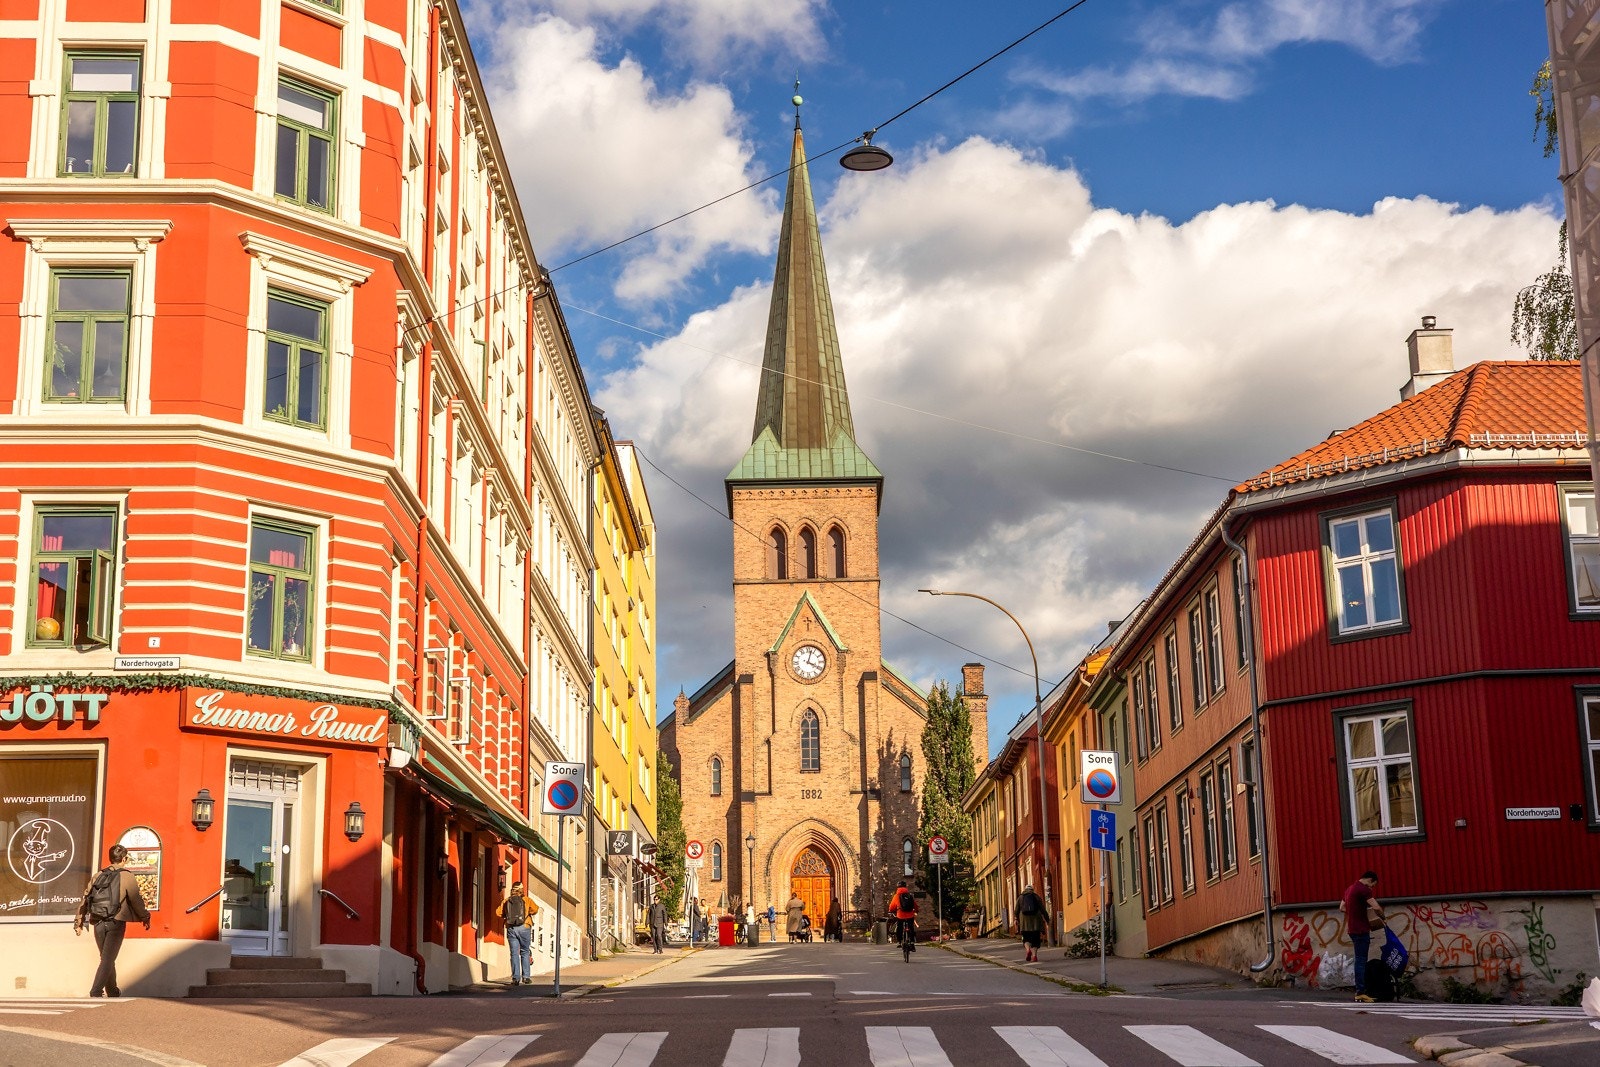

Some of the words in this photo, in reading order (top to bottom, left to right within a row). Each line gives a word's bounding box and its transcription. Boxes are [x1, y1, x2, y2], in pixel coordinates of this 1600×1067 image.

[121, 660, 174, 668] Norderhovgata
[0, 685, 108, 721] JÖTT
[192, 691, 298, 734] Gunnar
[301, 704, 387, 744] Ruud
[1088, 754, 1113, 764] Sone
[552, 764, 578, 775] Sone
[3, 794, 87, 804] www.gunnarruud.no
[801, 789, 823, 799] 1882
[1507, 808, 1560, 817] Norderhovgata
[37, 895, 50, 903] den
